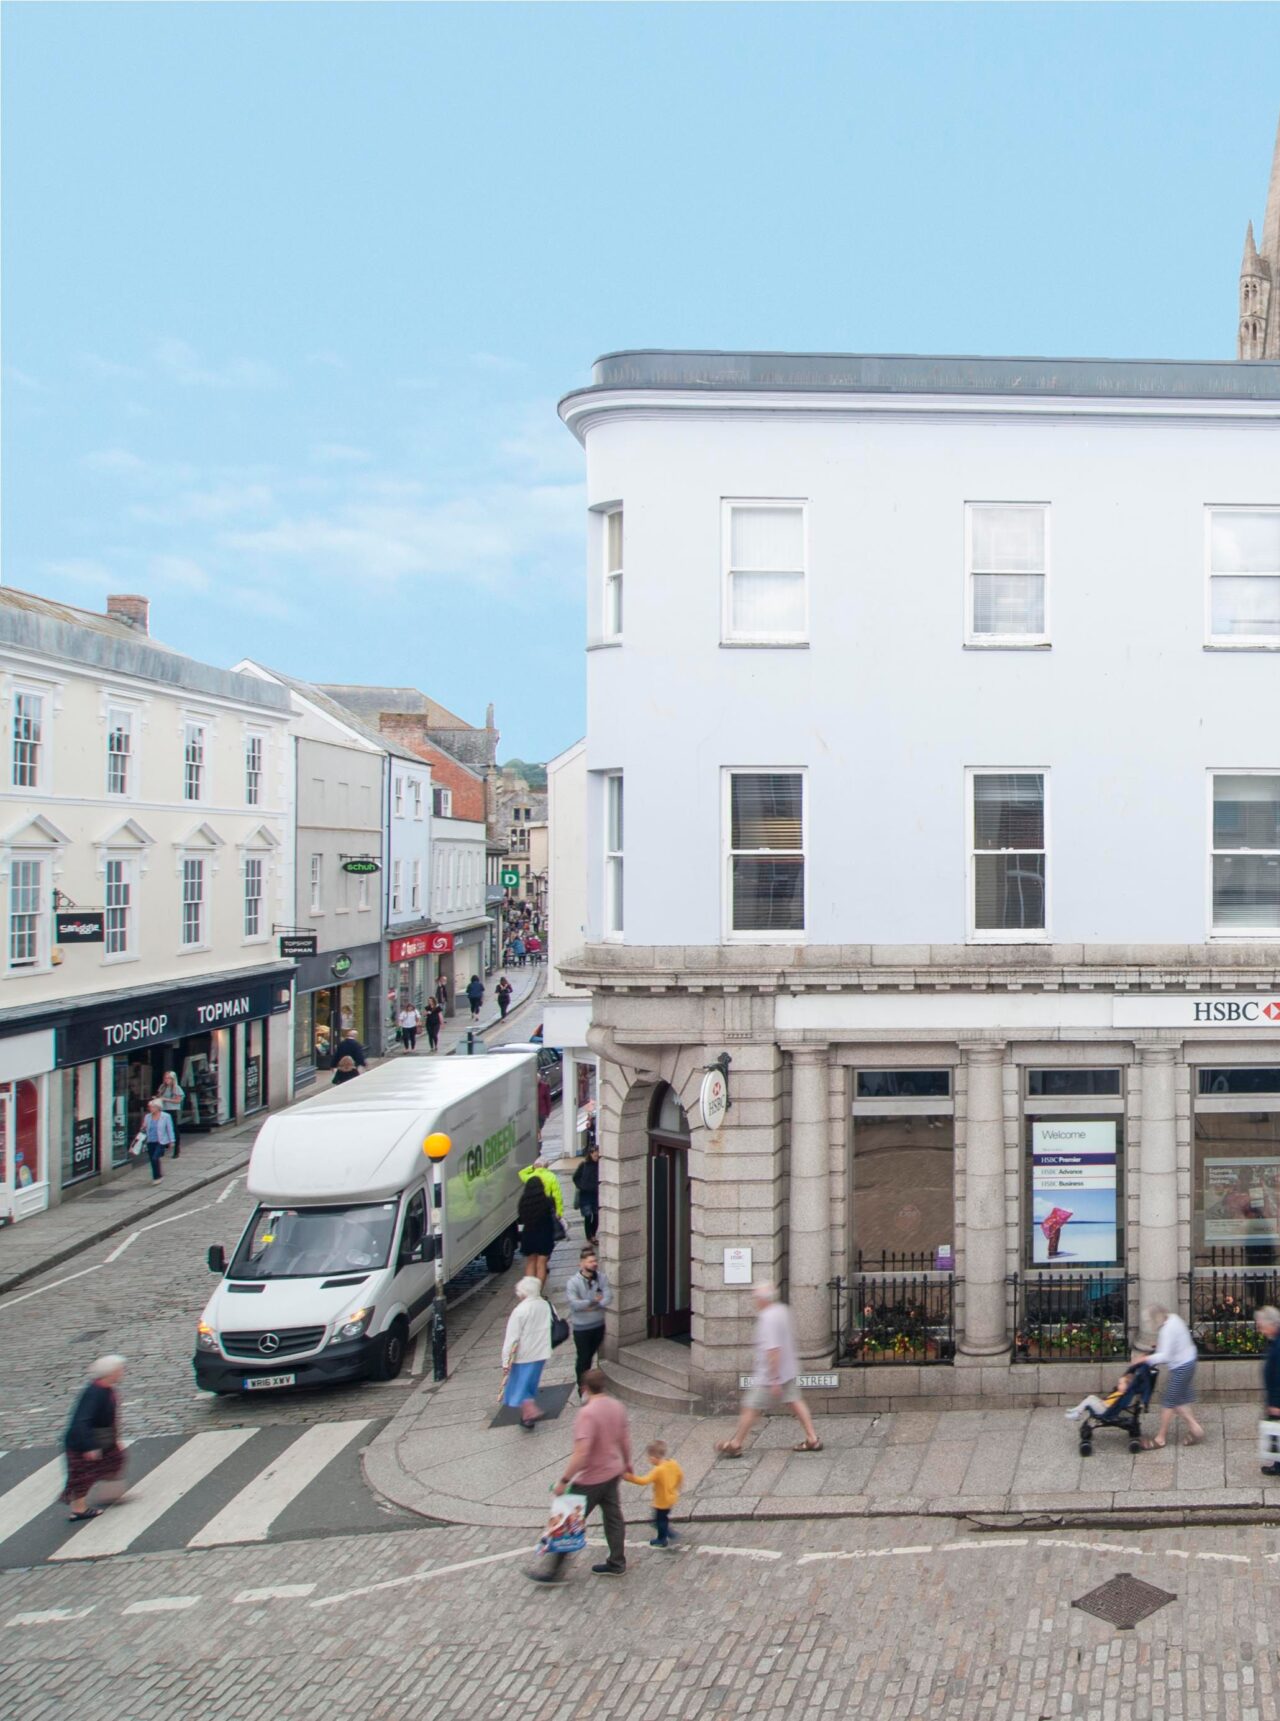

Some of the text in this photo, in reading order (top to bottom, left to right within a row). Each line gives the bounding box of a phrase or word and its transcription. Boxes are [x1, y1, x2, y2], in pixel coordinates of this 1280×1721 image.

[504, 874, 518, 885] D
[1193, 1002, 1260, 1021] HSBC
[103, 997, 250, 1046] TOPSHOP TOPMAN
[708, 1094, 725, 1117] HSBC
[75, 1132, 92, 1147] 30%
[1041, 1130, 1087, 1140] Welcome
[75, 1147, 92, 1162] OFF
[466, 1144, 482, 1182] GO
[800, 1375, 834, 1386] STREET
